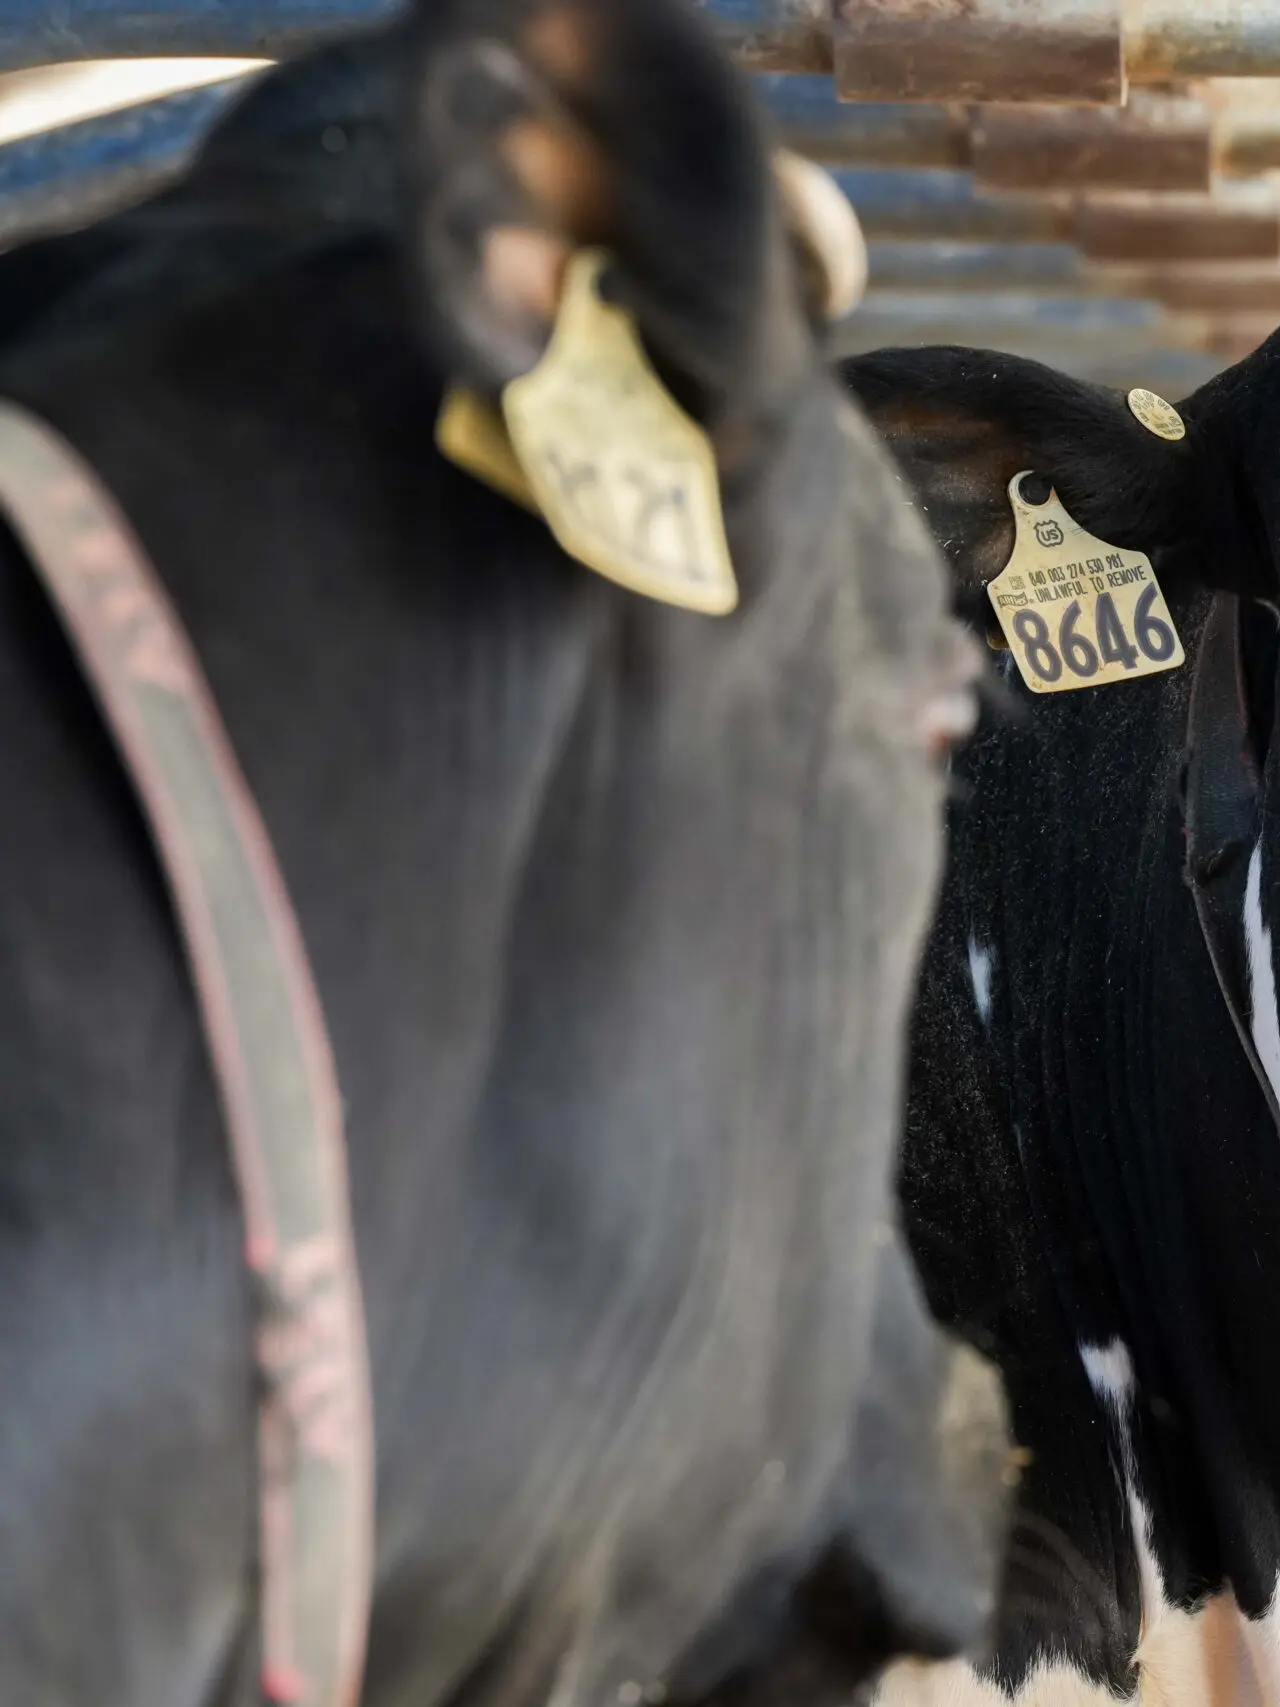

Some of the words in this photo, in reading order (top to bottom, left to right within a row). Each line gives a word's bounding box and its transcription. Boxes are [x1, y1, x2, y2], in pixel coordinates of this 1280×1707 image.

[1041, 528, 1059, 542] US
[1028, 572, 1046, 587] 840
[1048, 568, 1065, 582] 003
[1067, 562, 1086, 578] 274
[1086, 559, 1104, 575] 530
[1106, 553, 1124, 569] 981
[1034, 582, 1088, 603] UNLAWFUL
[1089, 576, 1105, 593] TO
[1107, 565, 1148, 587] REMOVE
[1012, 581, 1176, 683] 8646
